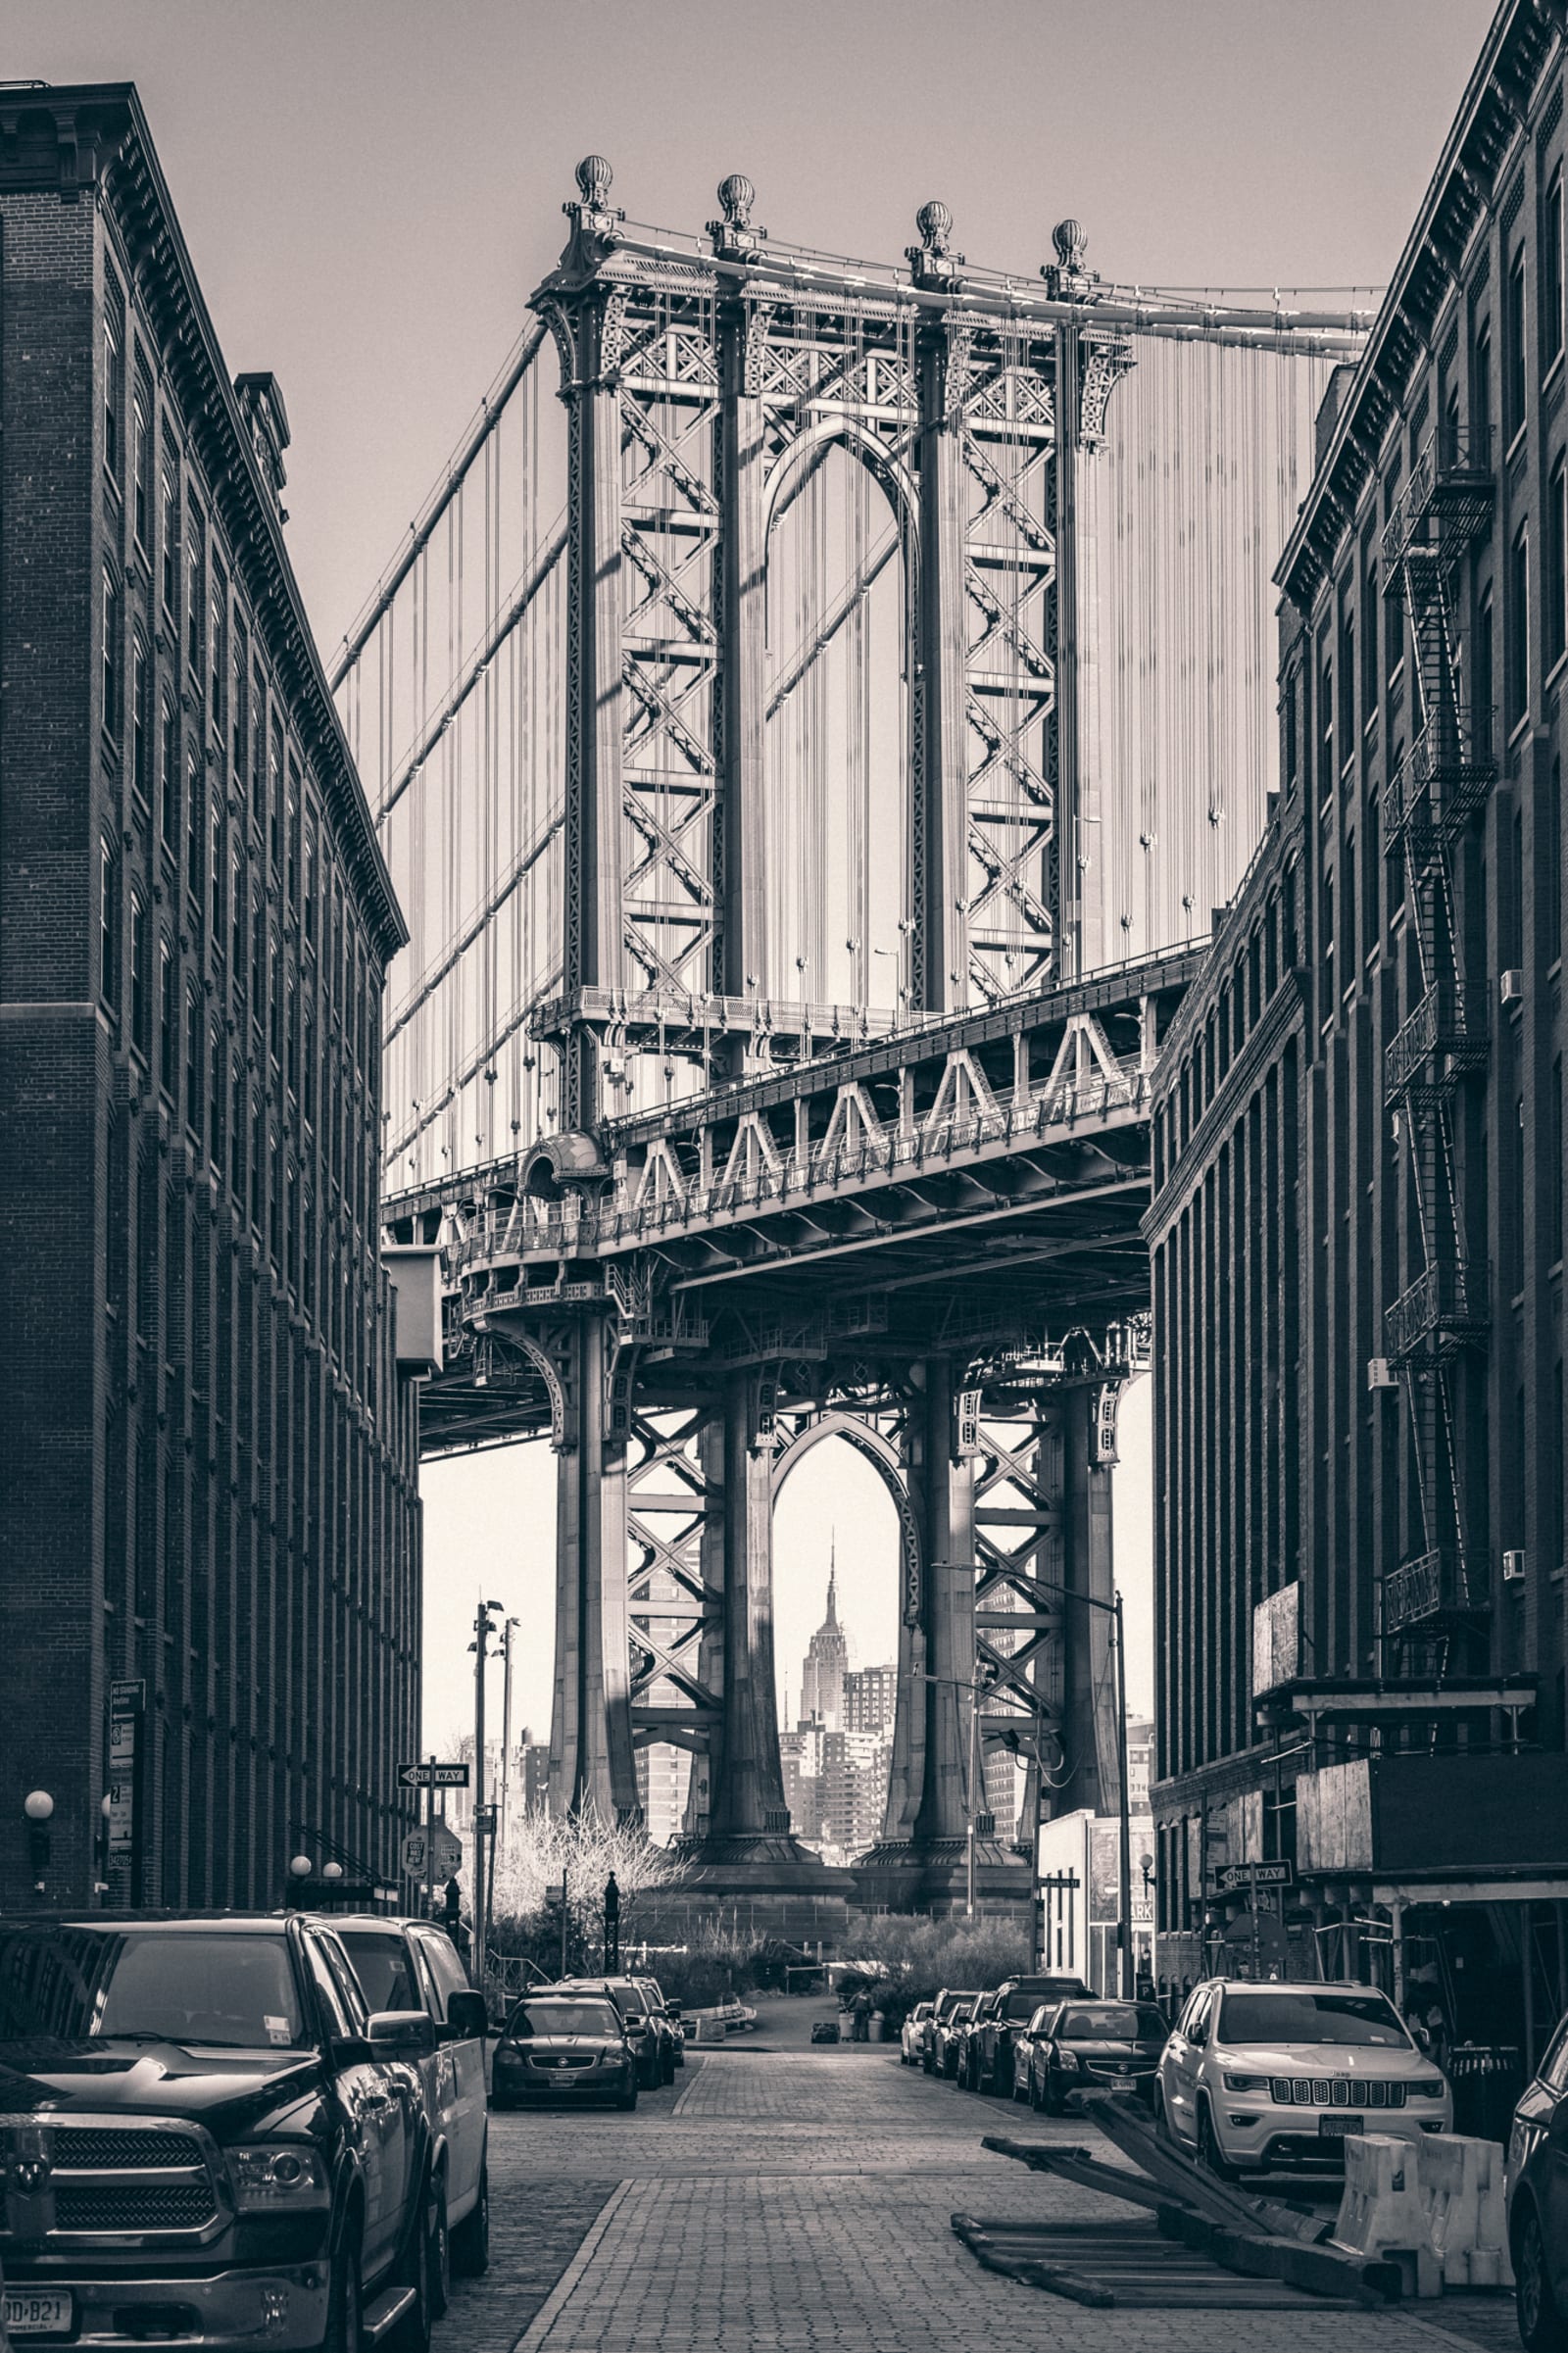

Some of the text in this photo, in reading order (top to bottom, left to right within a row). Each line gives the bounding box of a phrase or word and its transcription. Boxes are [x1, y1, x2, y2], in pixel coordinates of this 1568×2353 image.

[408, 1771, 460, 1781] ONE WAY
[112, 1786, 119, 1802] 2
[1226, 1868, 1280, 1882] ONE WAY
